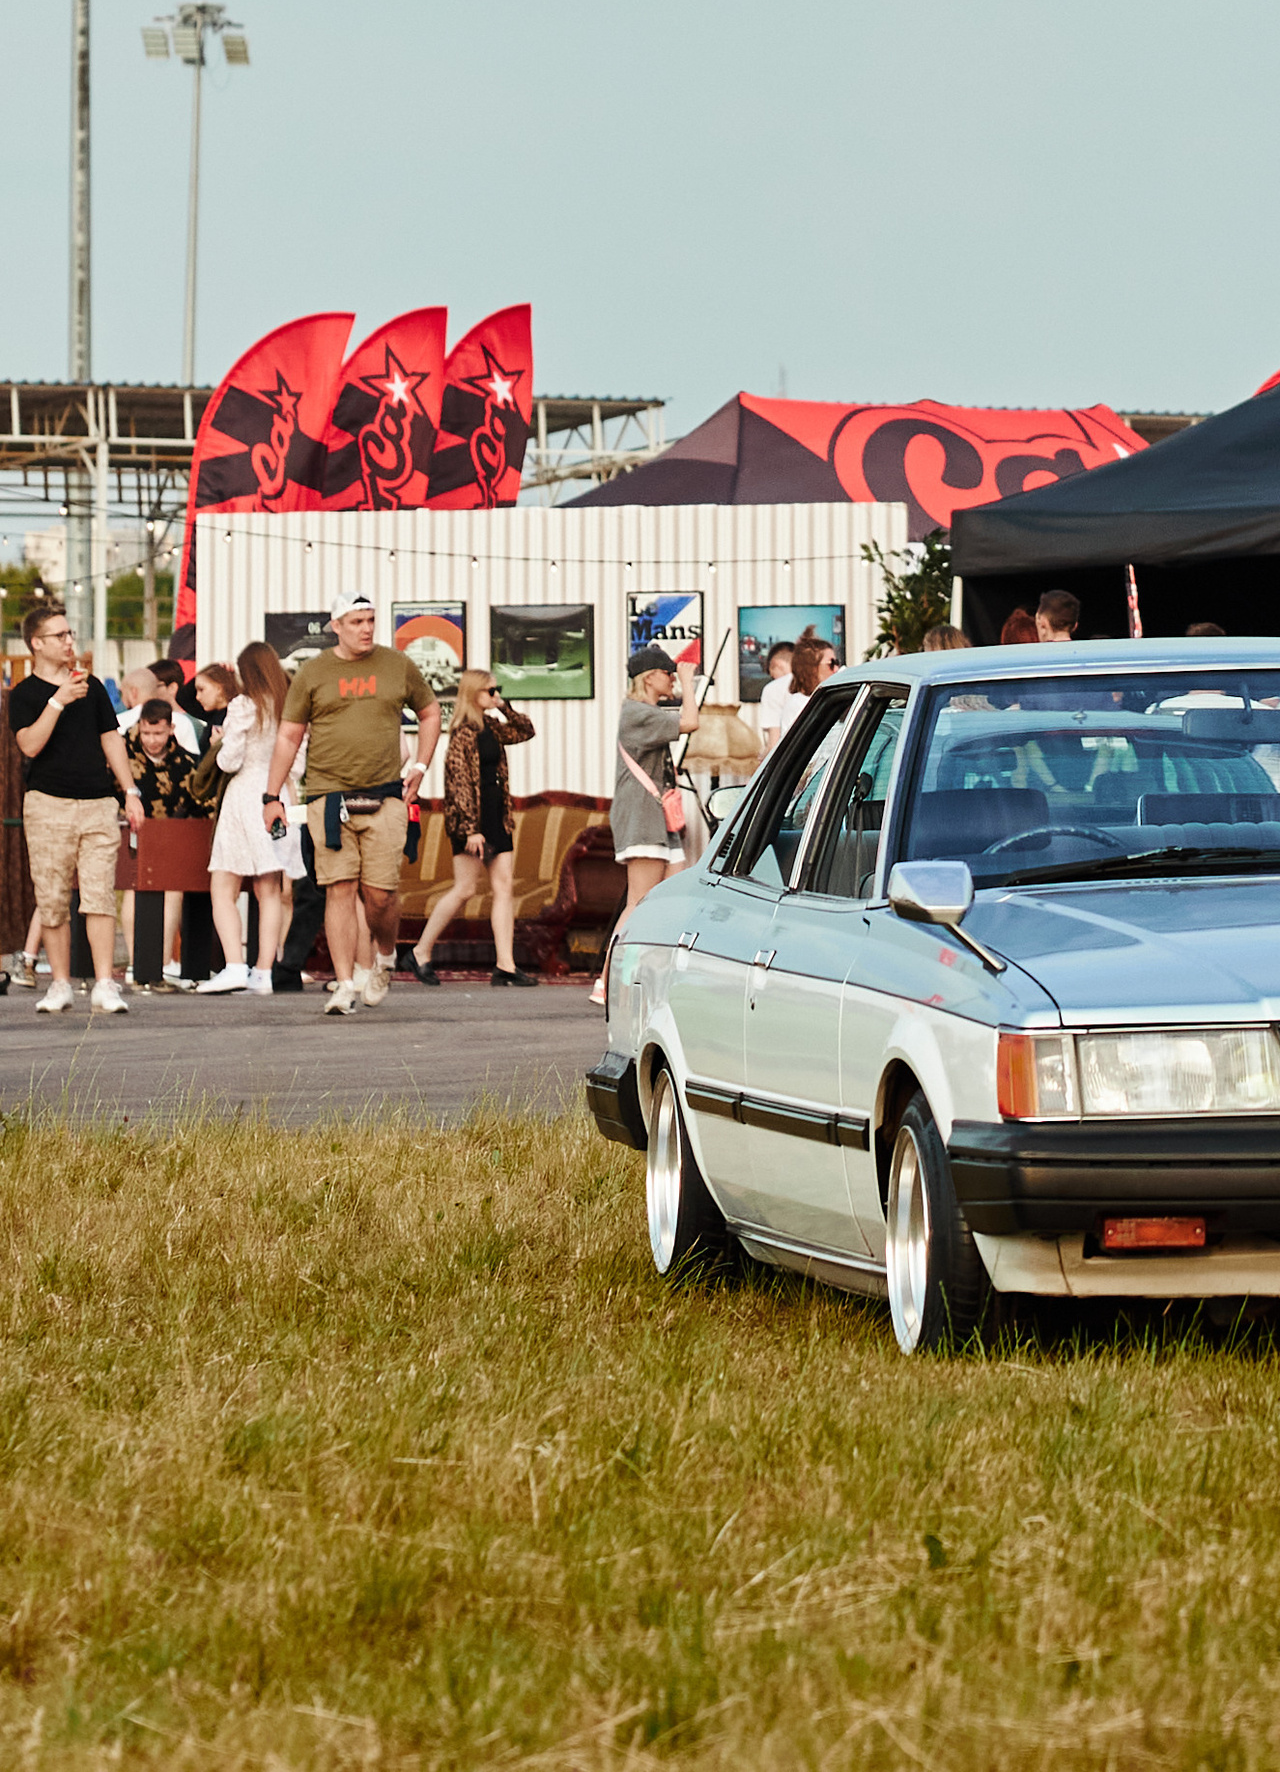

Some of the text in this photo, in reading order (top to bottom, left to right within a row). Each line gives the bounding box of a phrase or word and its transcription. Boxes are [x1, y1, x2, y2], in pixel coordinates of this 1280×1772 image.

[629, 596, 659, 617] Le
[630, 619, 701, 641] Mans
[338, 675, 376, 697] HH
